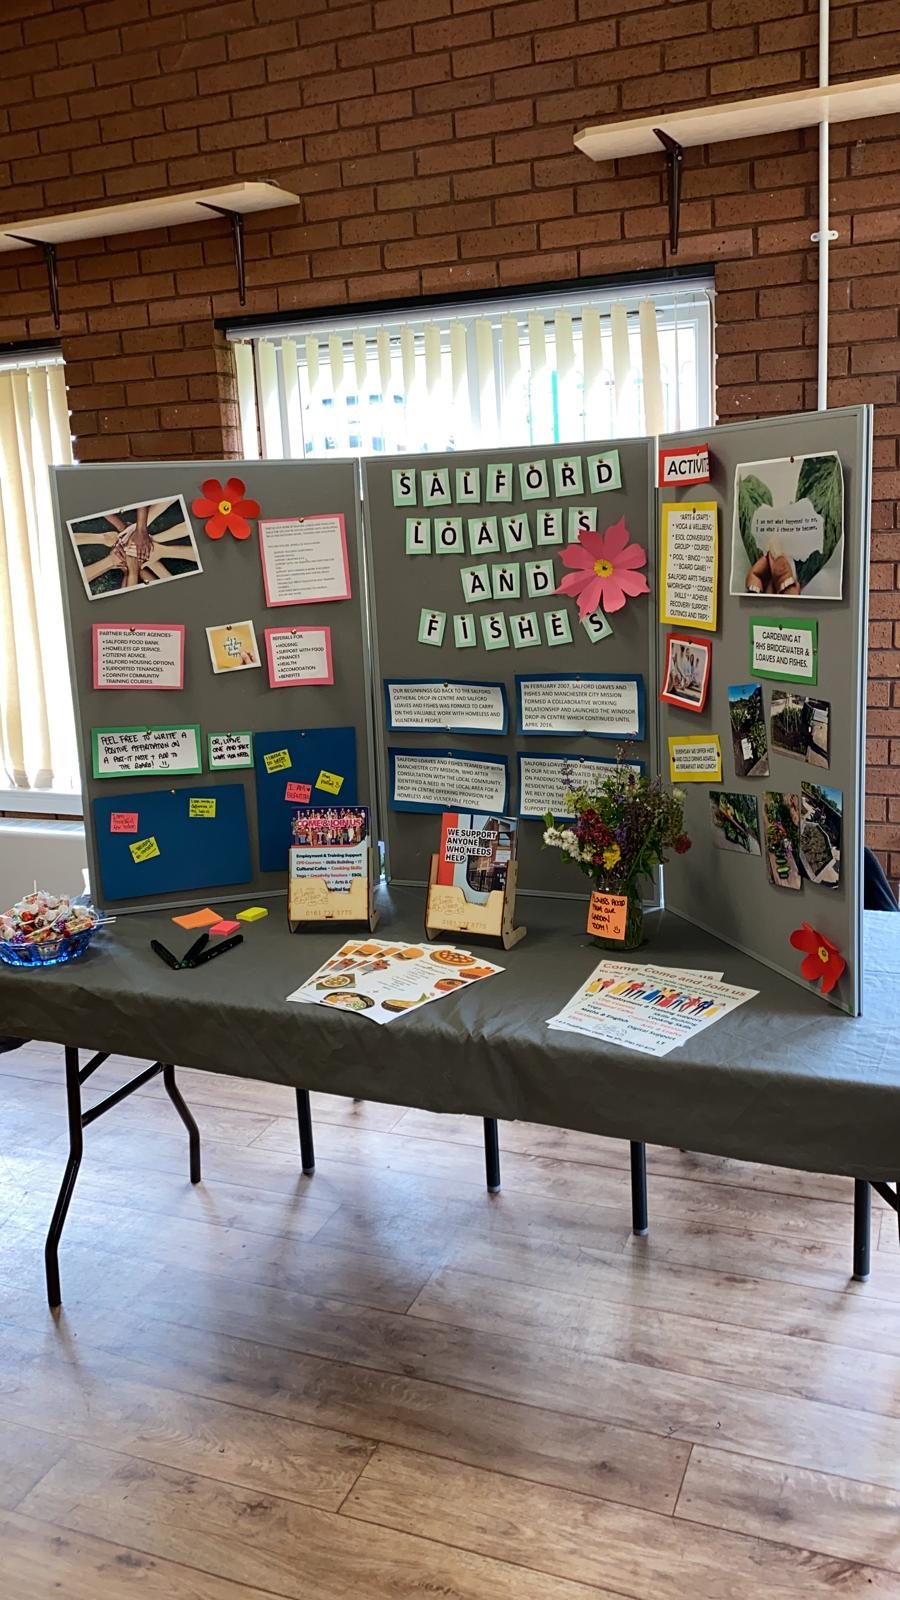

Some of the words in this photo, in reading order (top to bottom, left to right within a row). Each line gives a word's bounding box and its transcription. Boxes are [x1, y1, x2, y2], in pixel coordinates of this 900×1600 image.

[400, 464, 612, 496] SALFORD
[414, 515, 590, 545] LOAVES
[471, 572, 548, 593] AND
[427, 613, 604, 639] FISHES
[762, 632, 792, 642] GARDENING
[767, 645, 803, 656] BRIDGEWATER
[756, 653, 775, 662] LOAVES
[789, 658, 808, 667] FISHES.
[101, 736, 118, 745] FEEL
[119, 734, 138, 743] FREE
[154, 732, 177, 740] WRITE
[330, 819, 350, 828] JOIN
[461, 829, 497, 839] SUPPORT
[447, 837, 479, 846] ANYONE
[466, 847, 491, 856] NEEDS
[603, 962, 639, 972] Come
[644, 967, 678, 979] Come
[678, 975, 703, 985] and
[703, 982, 730, 991] Join
